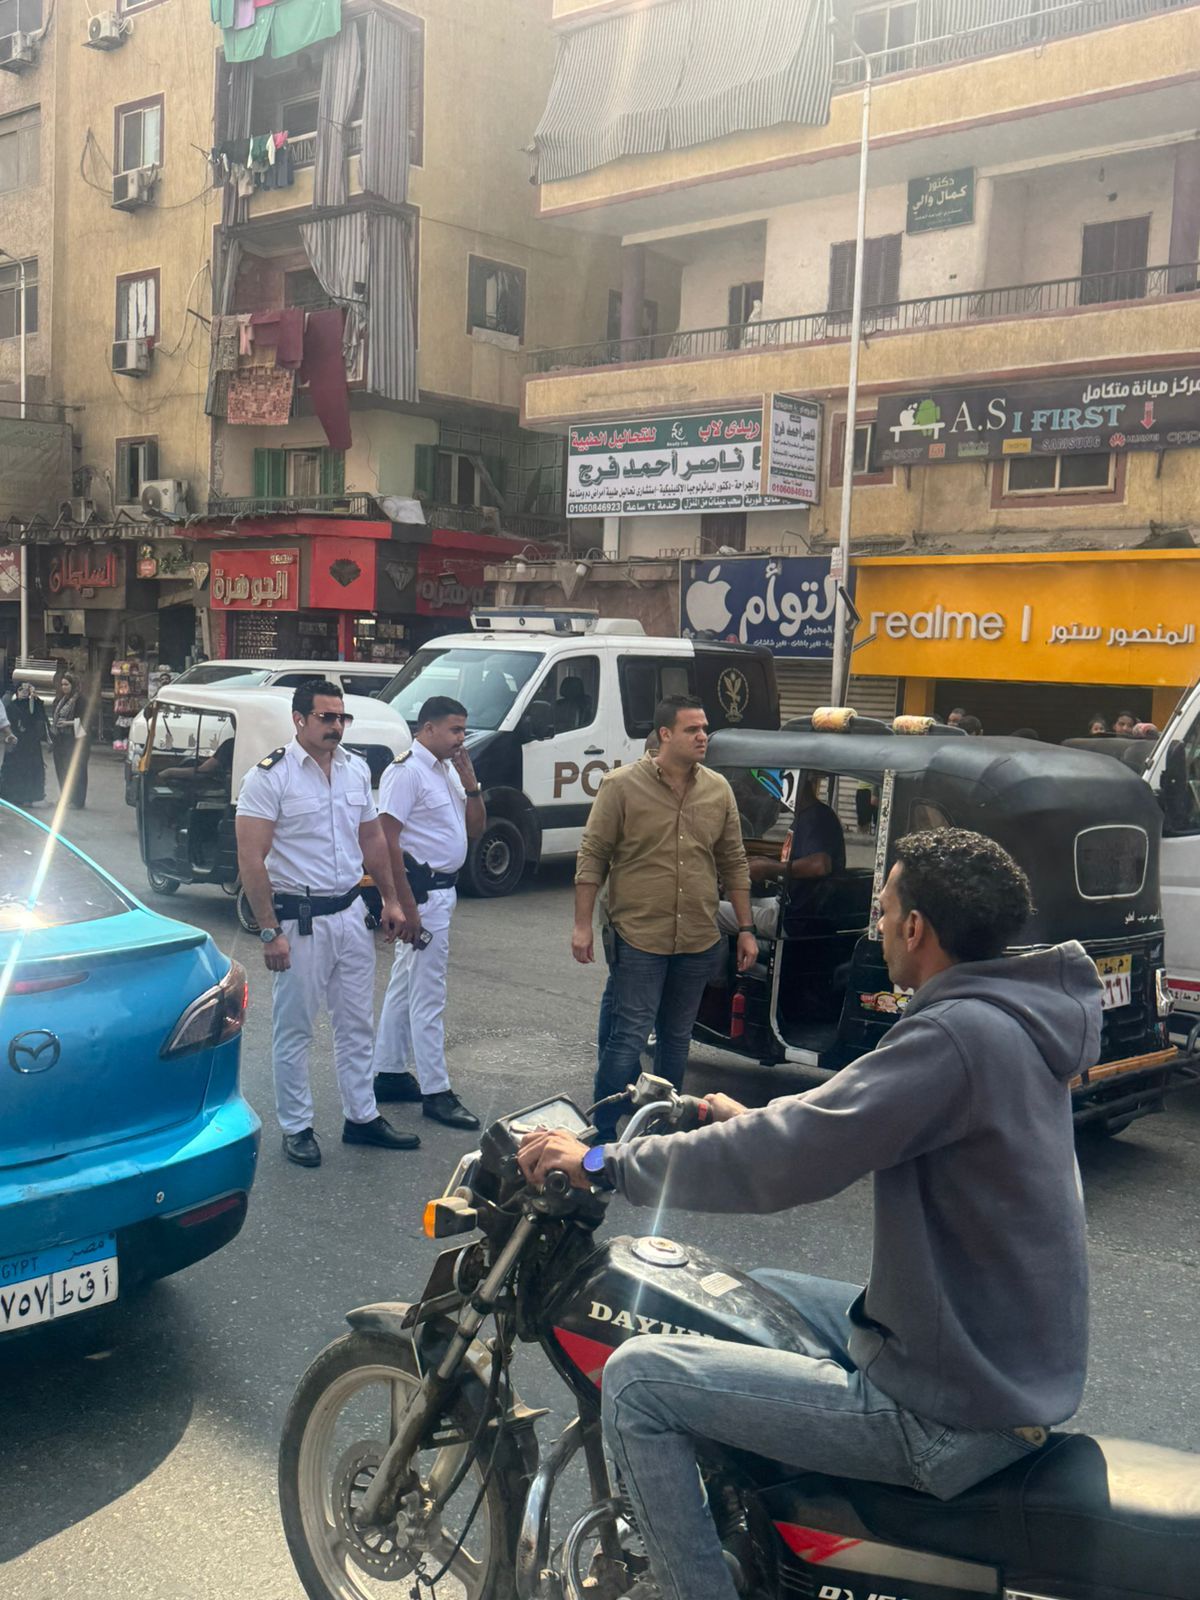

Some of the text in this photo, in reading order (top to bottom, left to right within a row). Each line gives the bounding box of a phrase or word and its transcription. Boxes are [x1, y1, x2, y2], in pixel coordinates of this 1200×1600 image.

[936, 184, 968, 206] كمال
[1082, 382, 1129, 403] متكامل
[1132, 380, 1168, 398] صيانة
[1031, 404, 1126, 431] FIRST
[571, 430, 607, 452] الطبية
[698, 419, 723, 442] لاب
[1042, 436, 1100, 450] SAMSUNG
[578, 455, 620, 488] فرج
[622, 449, 678, 479] أحمد
[679, 447, 745, 481] ناصر
[569, 502, 621, 513] 01060846923
[626, 502, 646, 511] ساعة
[657, 500, 677, 510] خدمة
[213, 568, 288, 607] الجوهرة
[739, 562, 836, 644] لتوأم
[869, 604, 1005, 640] realme
[1049, 622, 1195, 646] المنصور ستور
[67, 1241, 104, 1262] مصر
[0, 1256, 38, 1279] GYPT
